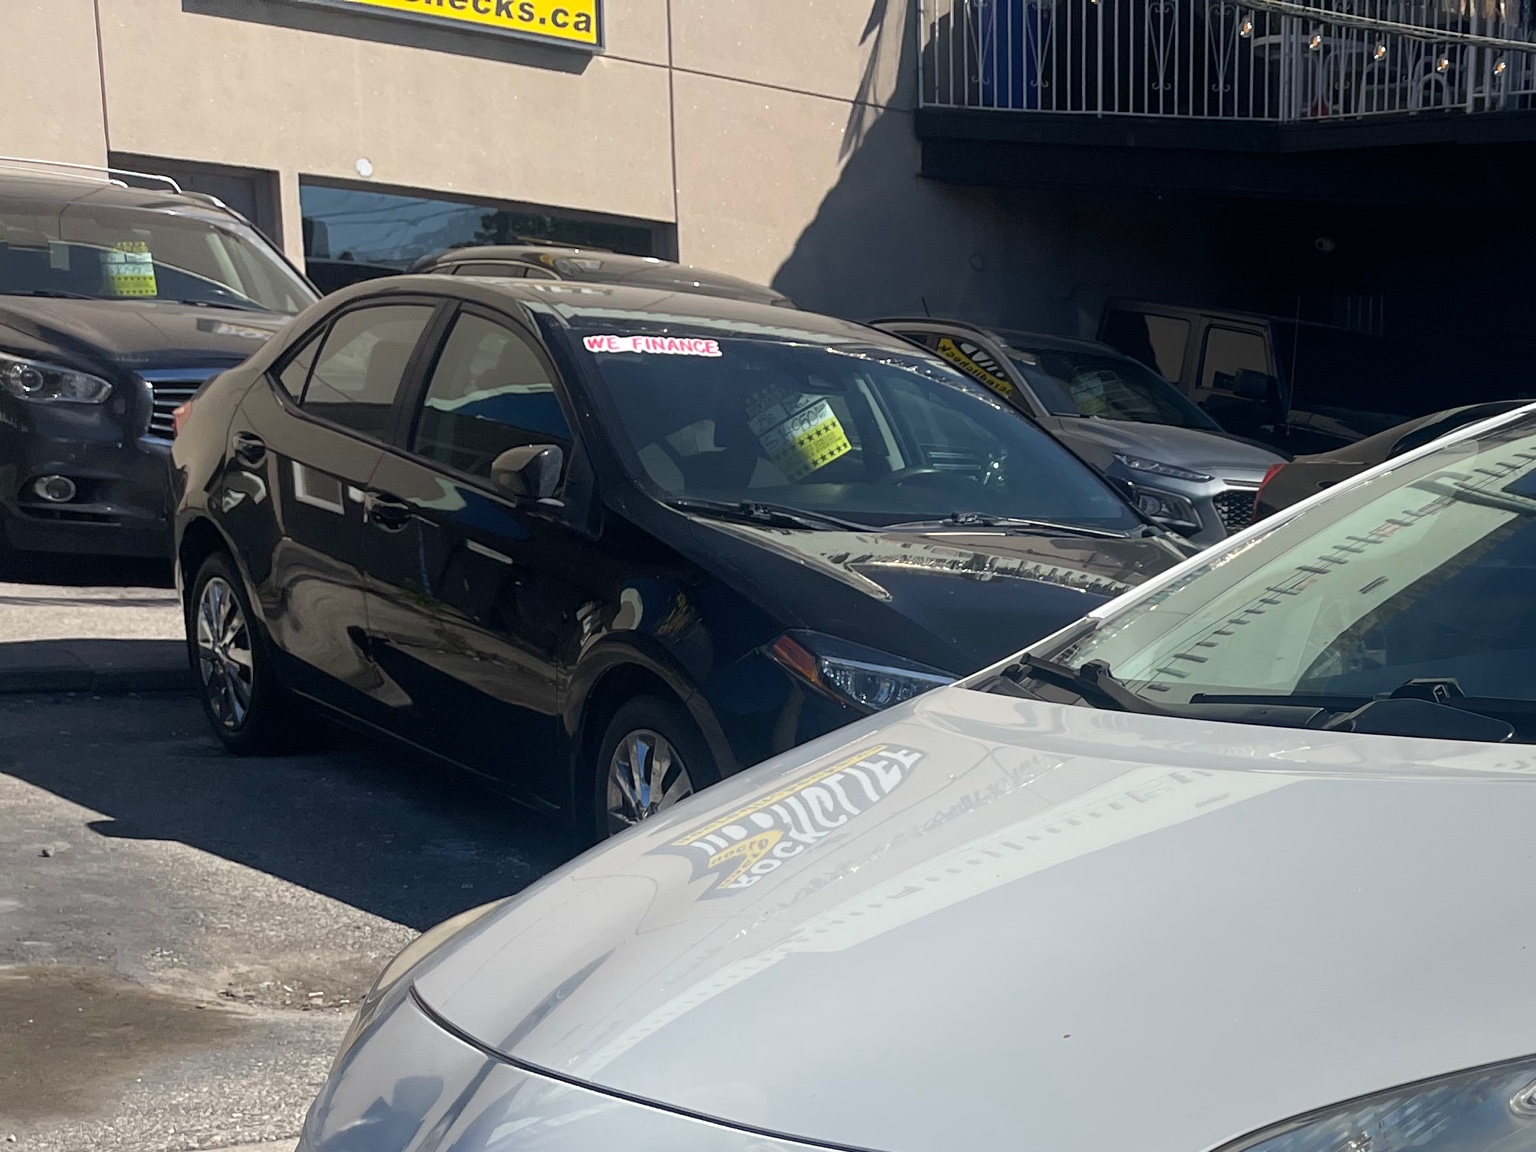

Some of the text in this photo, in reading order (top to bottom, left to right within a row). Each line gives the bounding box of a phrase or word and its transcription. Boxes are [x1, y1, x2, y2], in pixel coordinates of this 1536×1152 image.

[411, 0, 593, 33] ecks.ca
[587, 336, 717, 354] WE FINANCE
